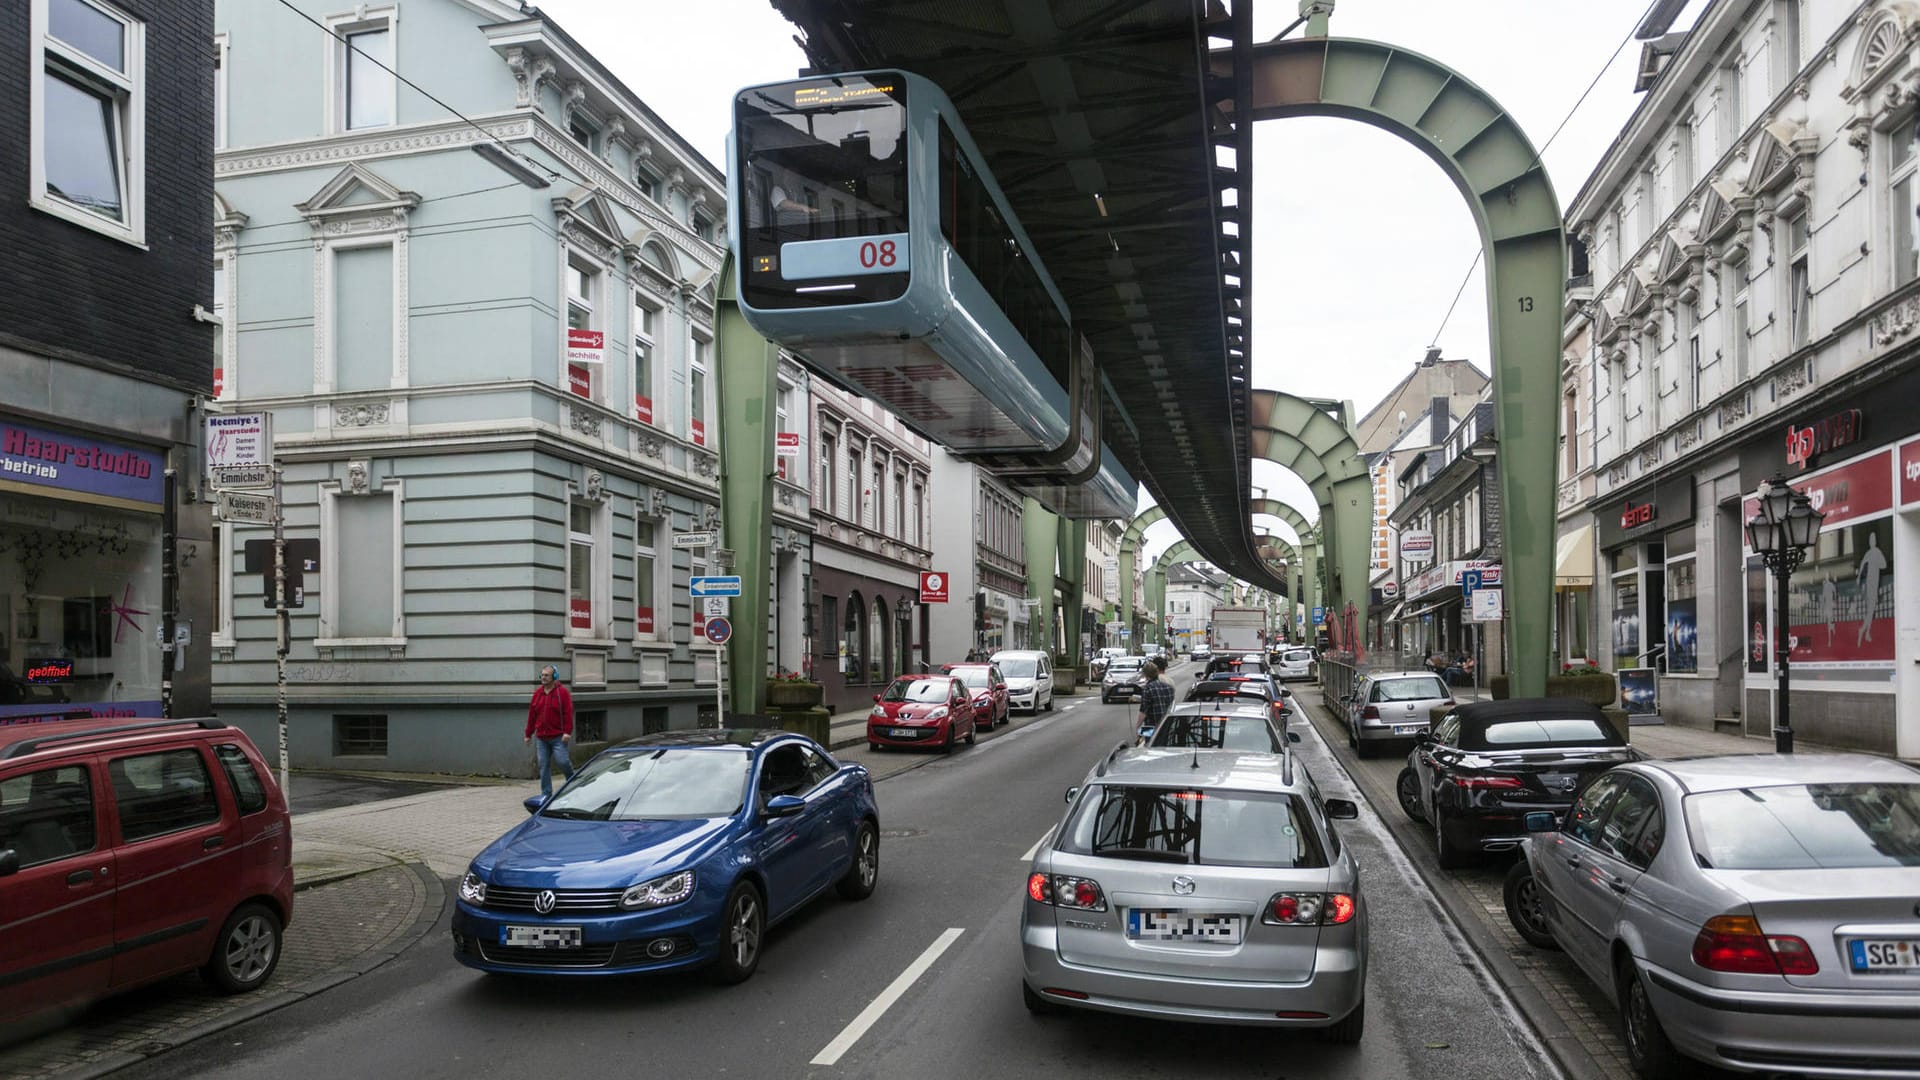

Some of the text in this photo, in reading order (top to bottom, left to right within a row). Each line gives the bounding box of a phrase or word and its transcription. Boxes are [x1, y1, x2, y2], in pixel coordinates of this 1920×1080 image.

[859, 240, 897, 268] 08
[1518, 296, 1533, 312] 13
[3, 427, 151, 479] Haarstudio
[1467, 575, 1477, 593] P
[28, 664, 71, 680] geöffnet
